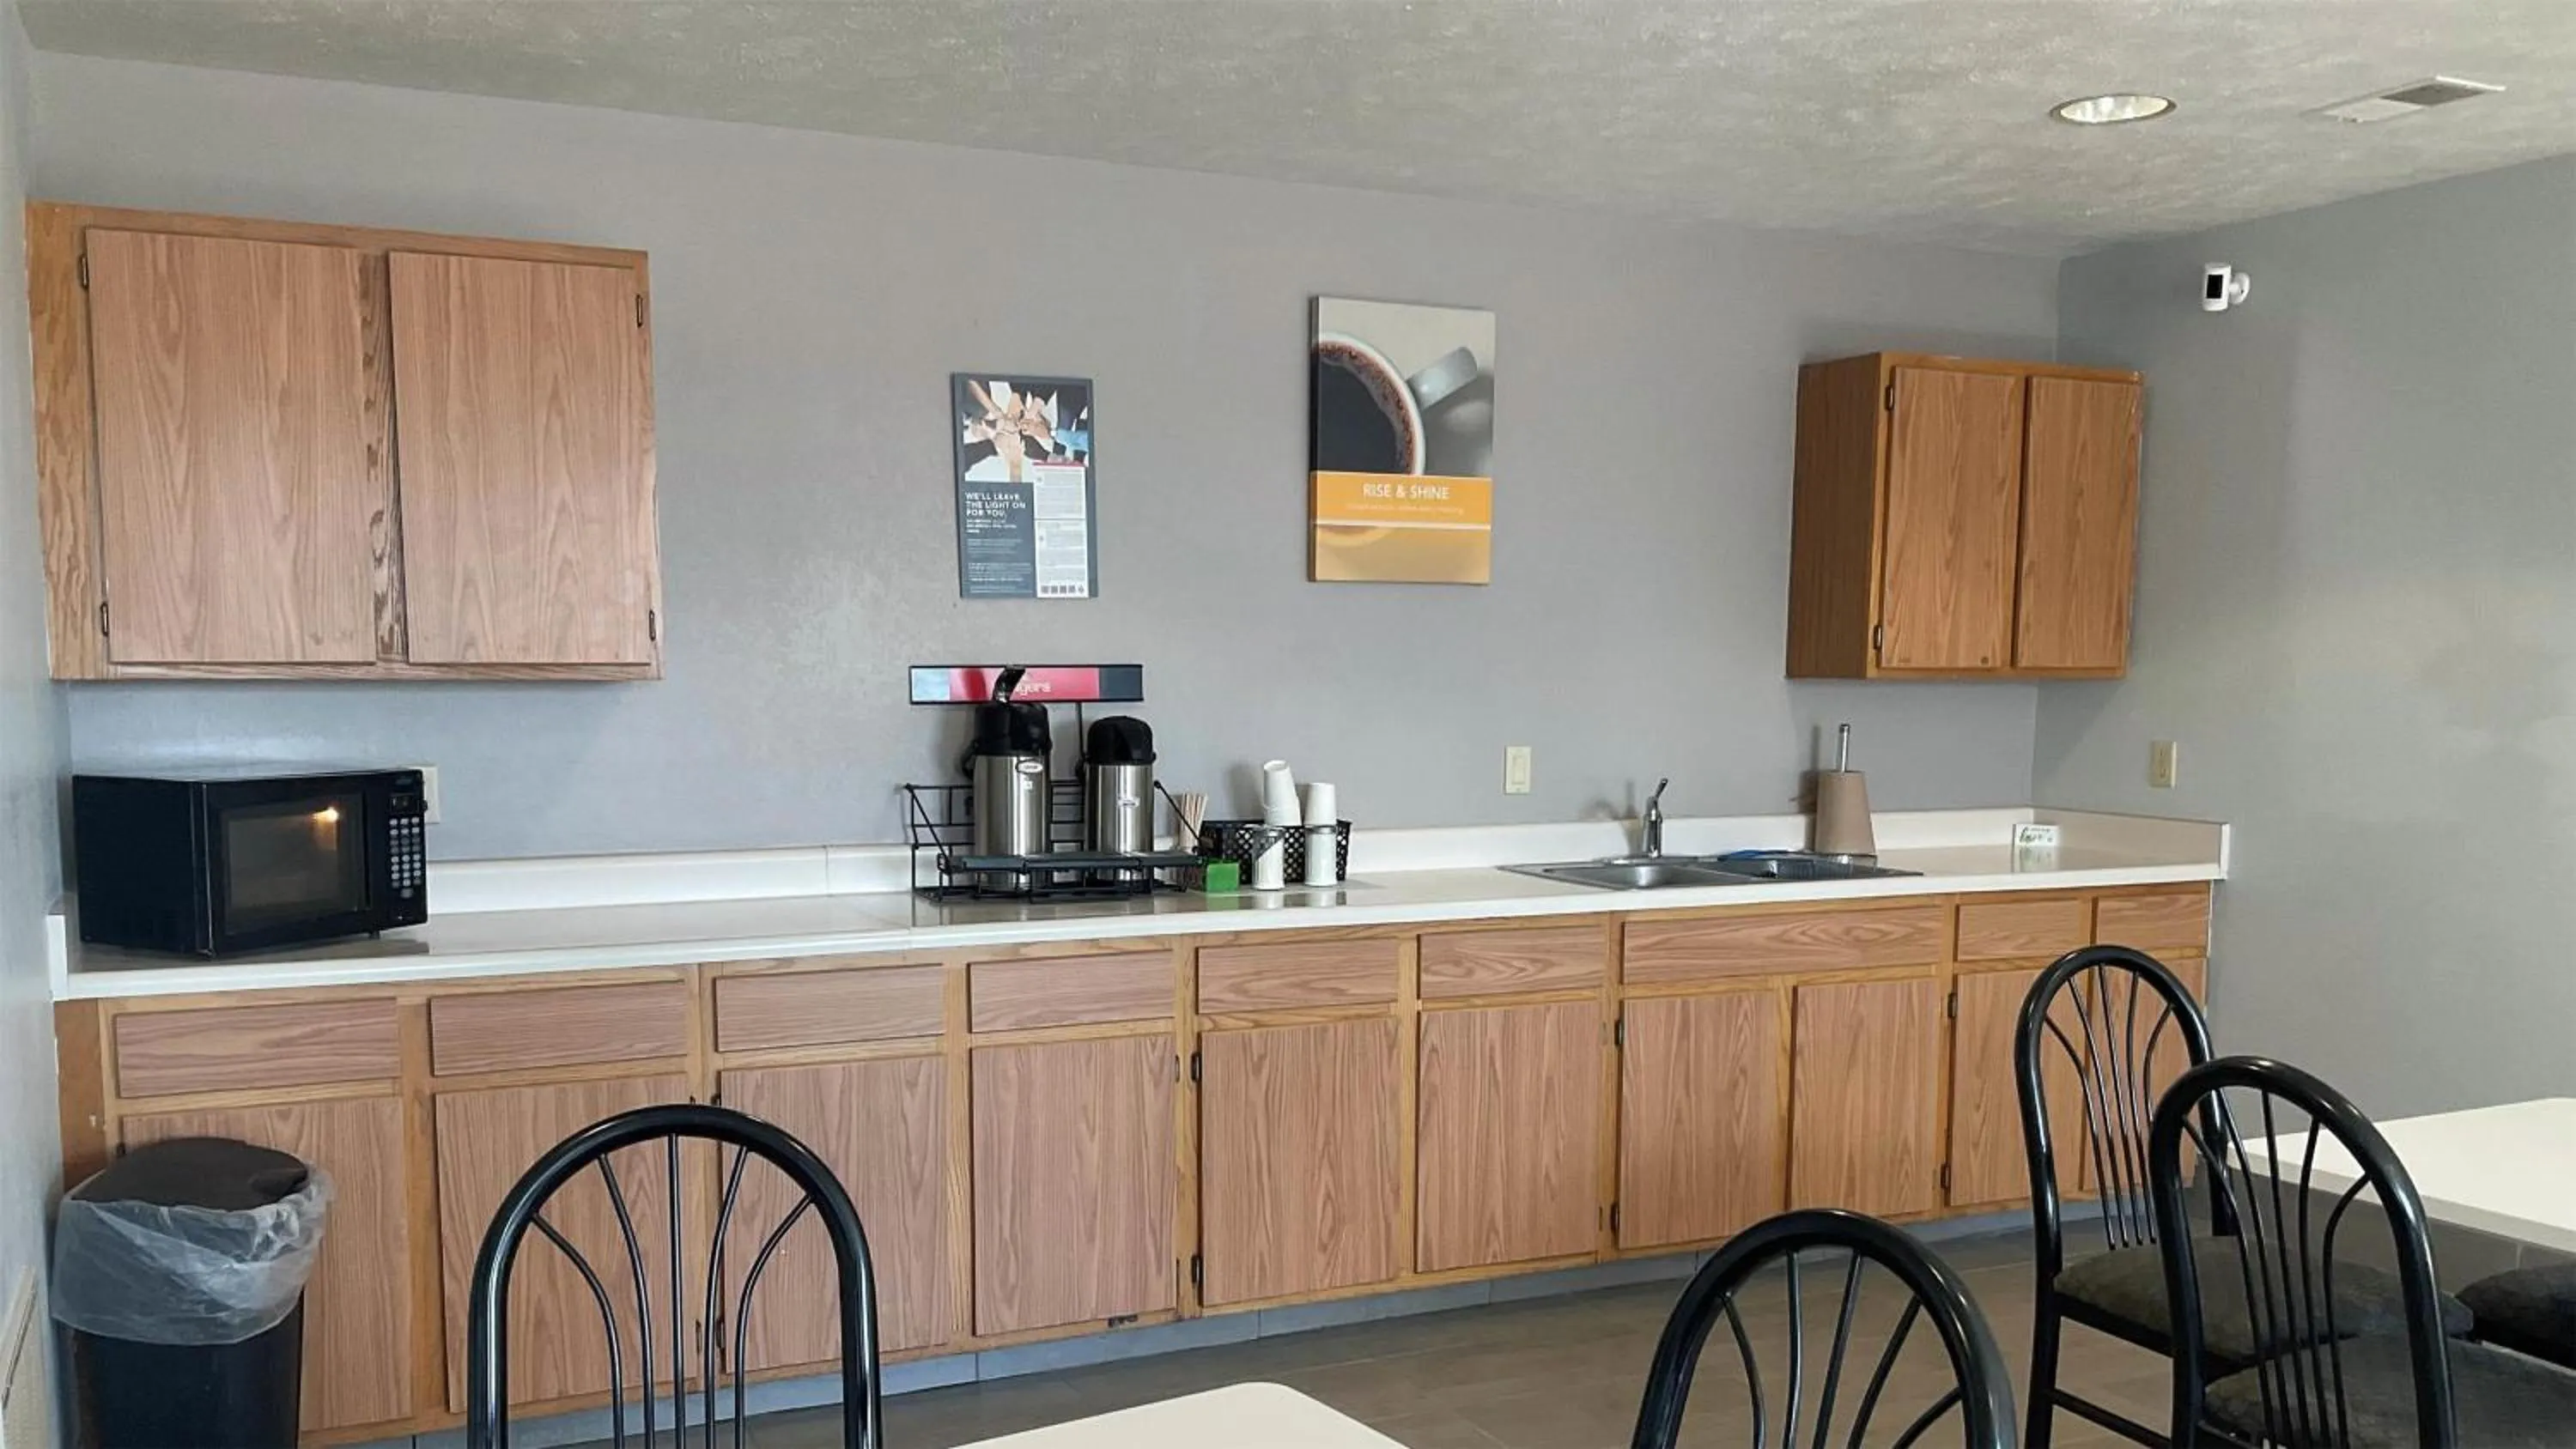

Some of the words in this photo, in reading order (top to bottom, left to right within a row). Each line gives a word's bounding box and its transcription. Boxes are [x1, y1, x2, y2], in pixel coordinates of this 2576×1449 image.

[1363, 483, 1391, 498] RISE
[1395, 483, 1406, 499] &
[1410, 483, 1449, 500] SHINE
[965, 500, 983, 509] THE
